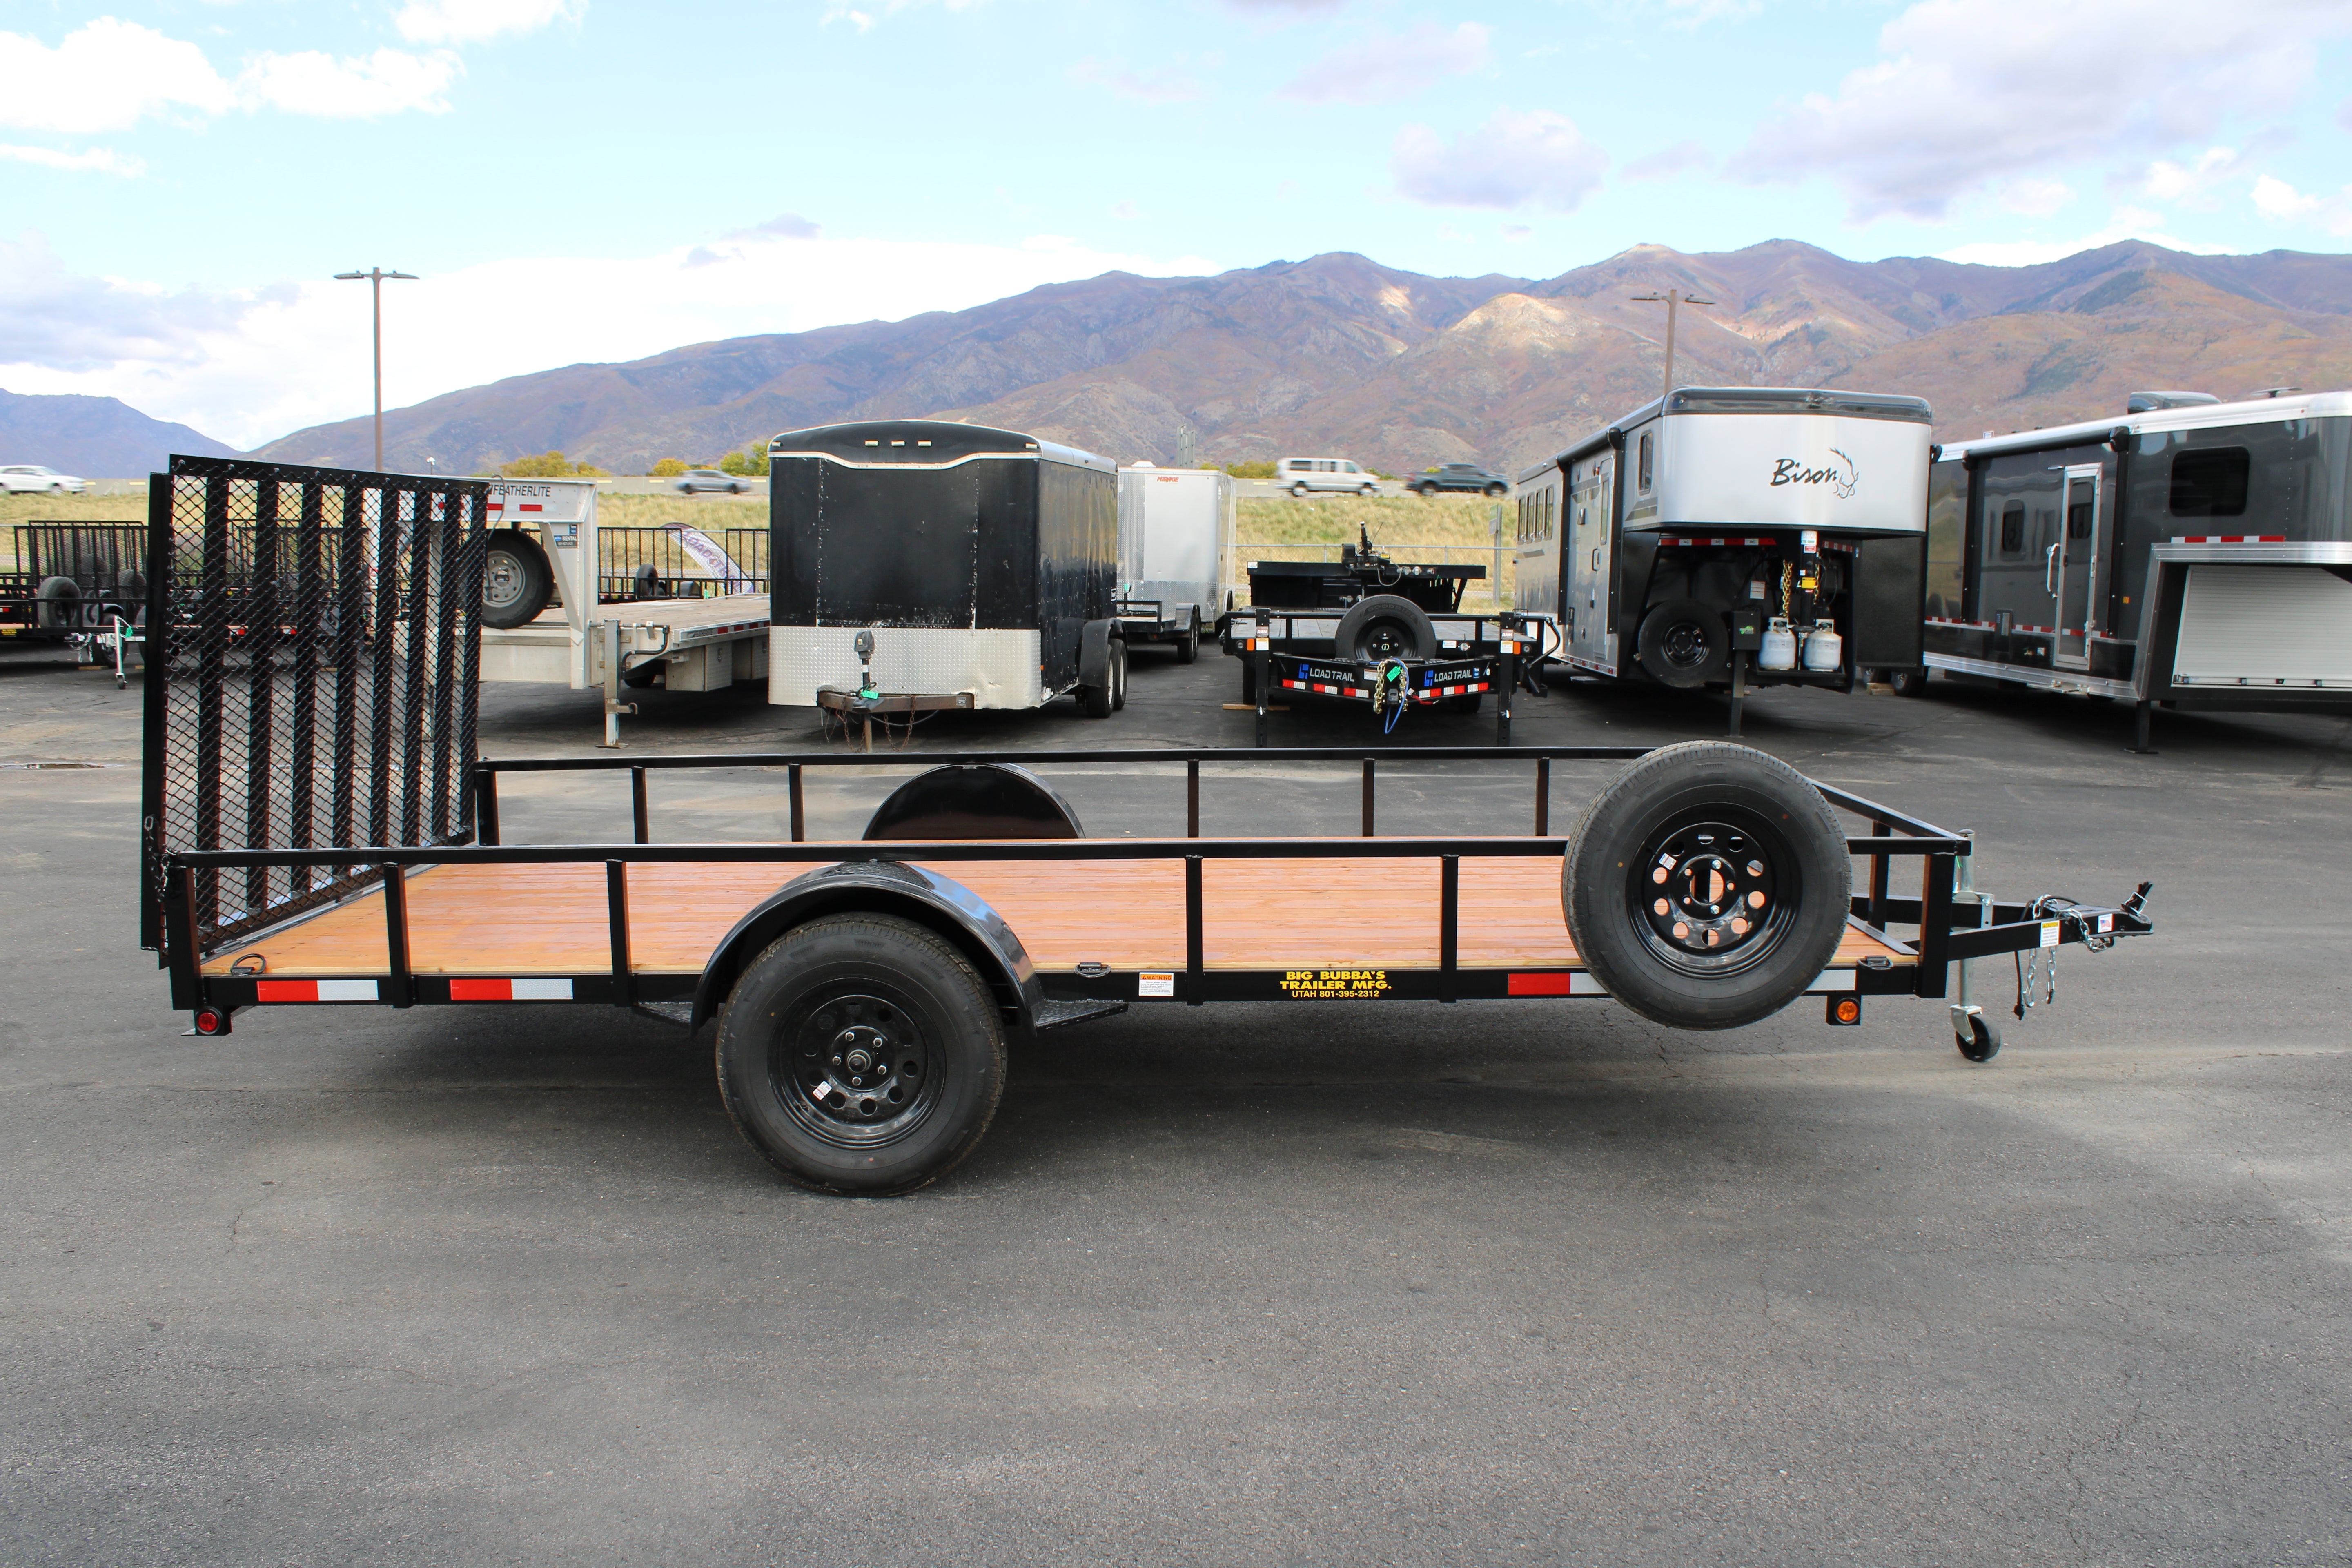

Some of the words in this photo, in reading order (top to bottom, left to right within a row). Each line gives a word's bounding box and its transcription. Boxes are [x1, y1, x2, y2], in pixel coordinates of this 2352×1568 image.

[1770, 459, 1837, 486] Bison
[493, 485, 551, 497] FEATHERLITE
[1310, 668, 1330, 679] LOAD
[1332, 671, 1354, 682] TRAIL
[1434, 672, 1452, 682] LOAD
[1454, 670, 1472, 679] TRAIL
[1286, 971, 1313, 980] BIG
[1320, 971, 1385, 980] BUBBA'S
[1280, 980, 1346, 989] TRAILER
[1352, 980, 1392, 989] MFG.
